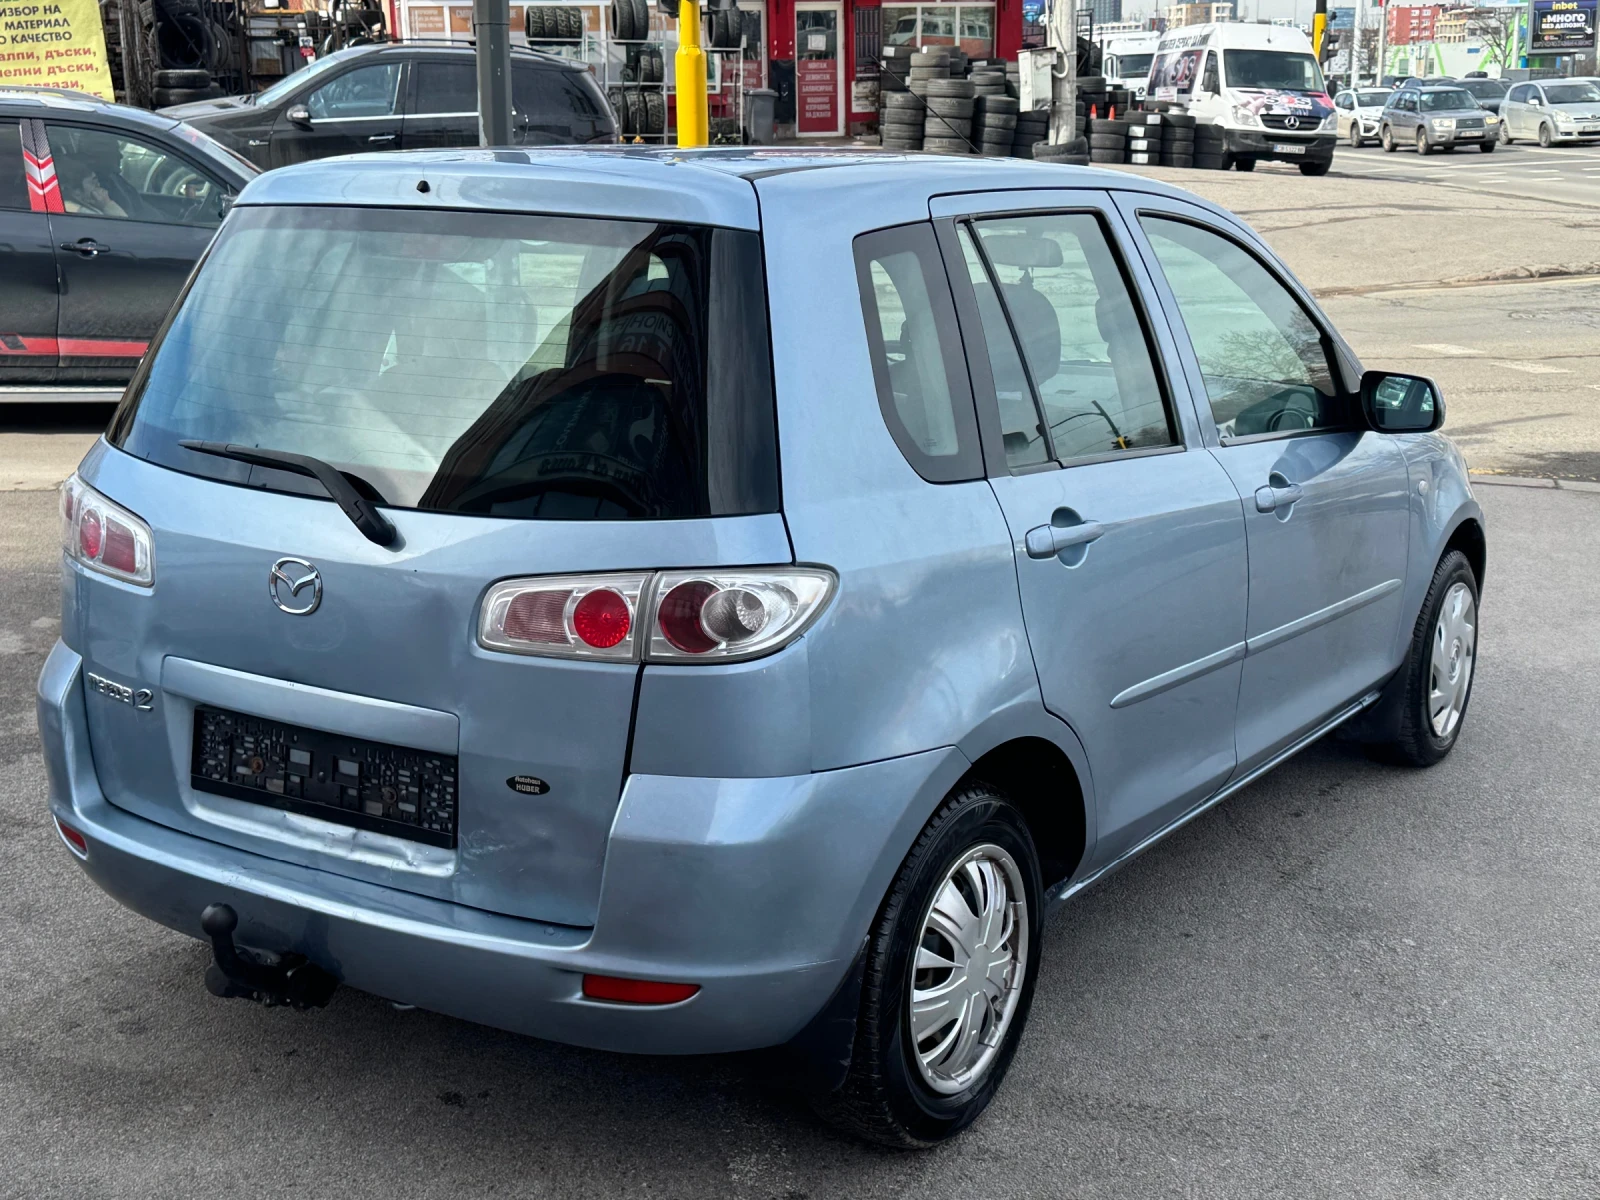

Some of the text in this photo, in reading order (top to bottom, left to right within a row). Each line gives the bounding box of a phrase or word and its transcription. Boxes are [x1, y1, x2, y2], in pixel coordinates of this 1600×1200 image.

[43, 5, 61, 15] НА
[1552, 2, 1578, 10] inbet
[4, 18, 70, 31] МАТЕРИАЛ
[11, 31, 73, 44] КАЧЕСТВО
[45, 47, 97, 60] дъски,
[0, 63, 99, 77] елни дъски,
[1170, 56, 1197, 82] SOS
[1263, 95, 1313, 107] SOS
[516, 784, 540, 793] HUBER
